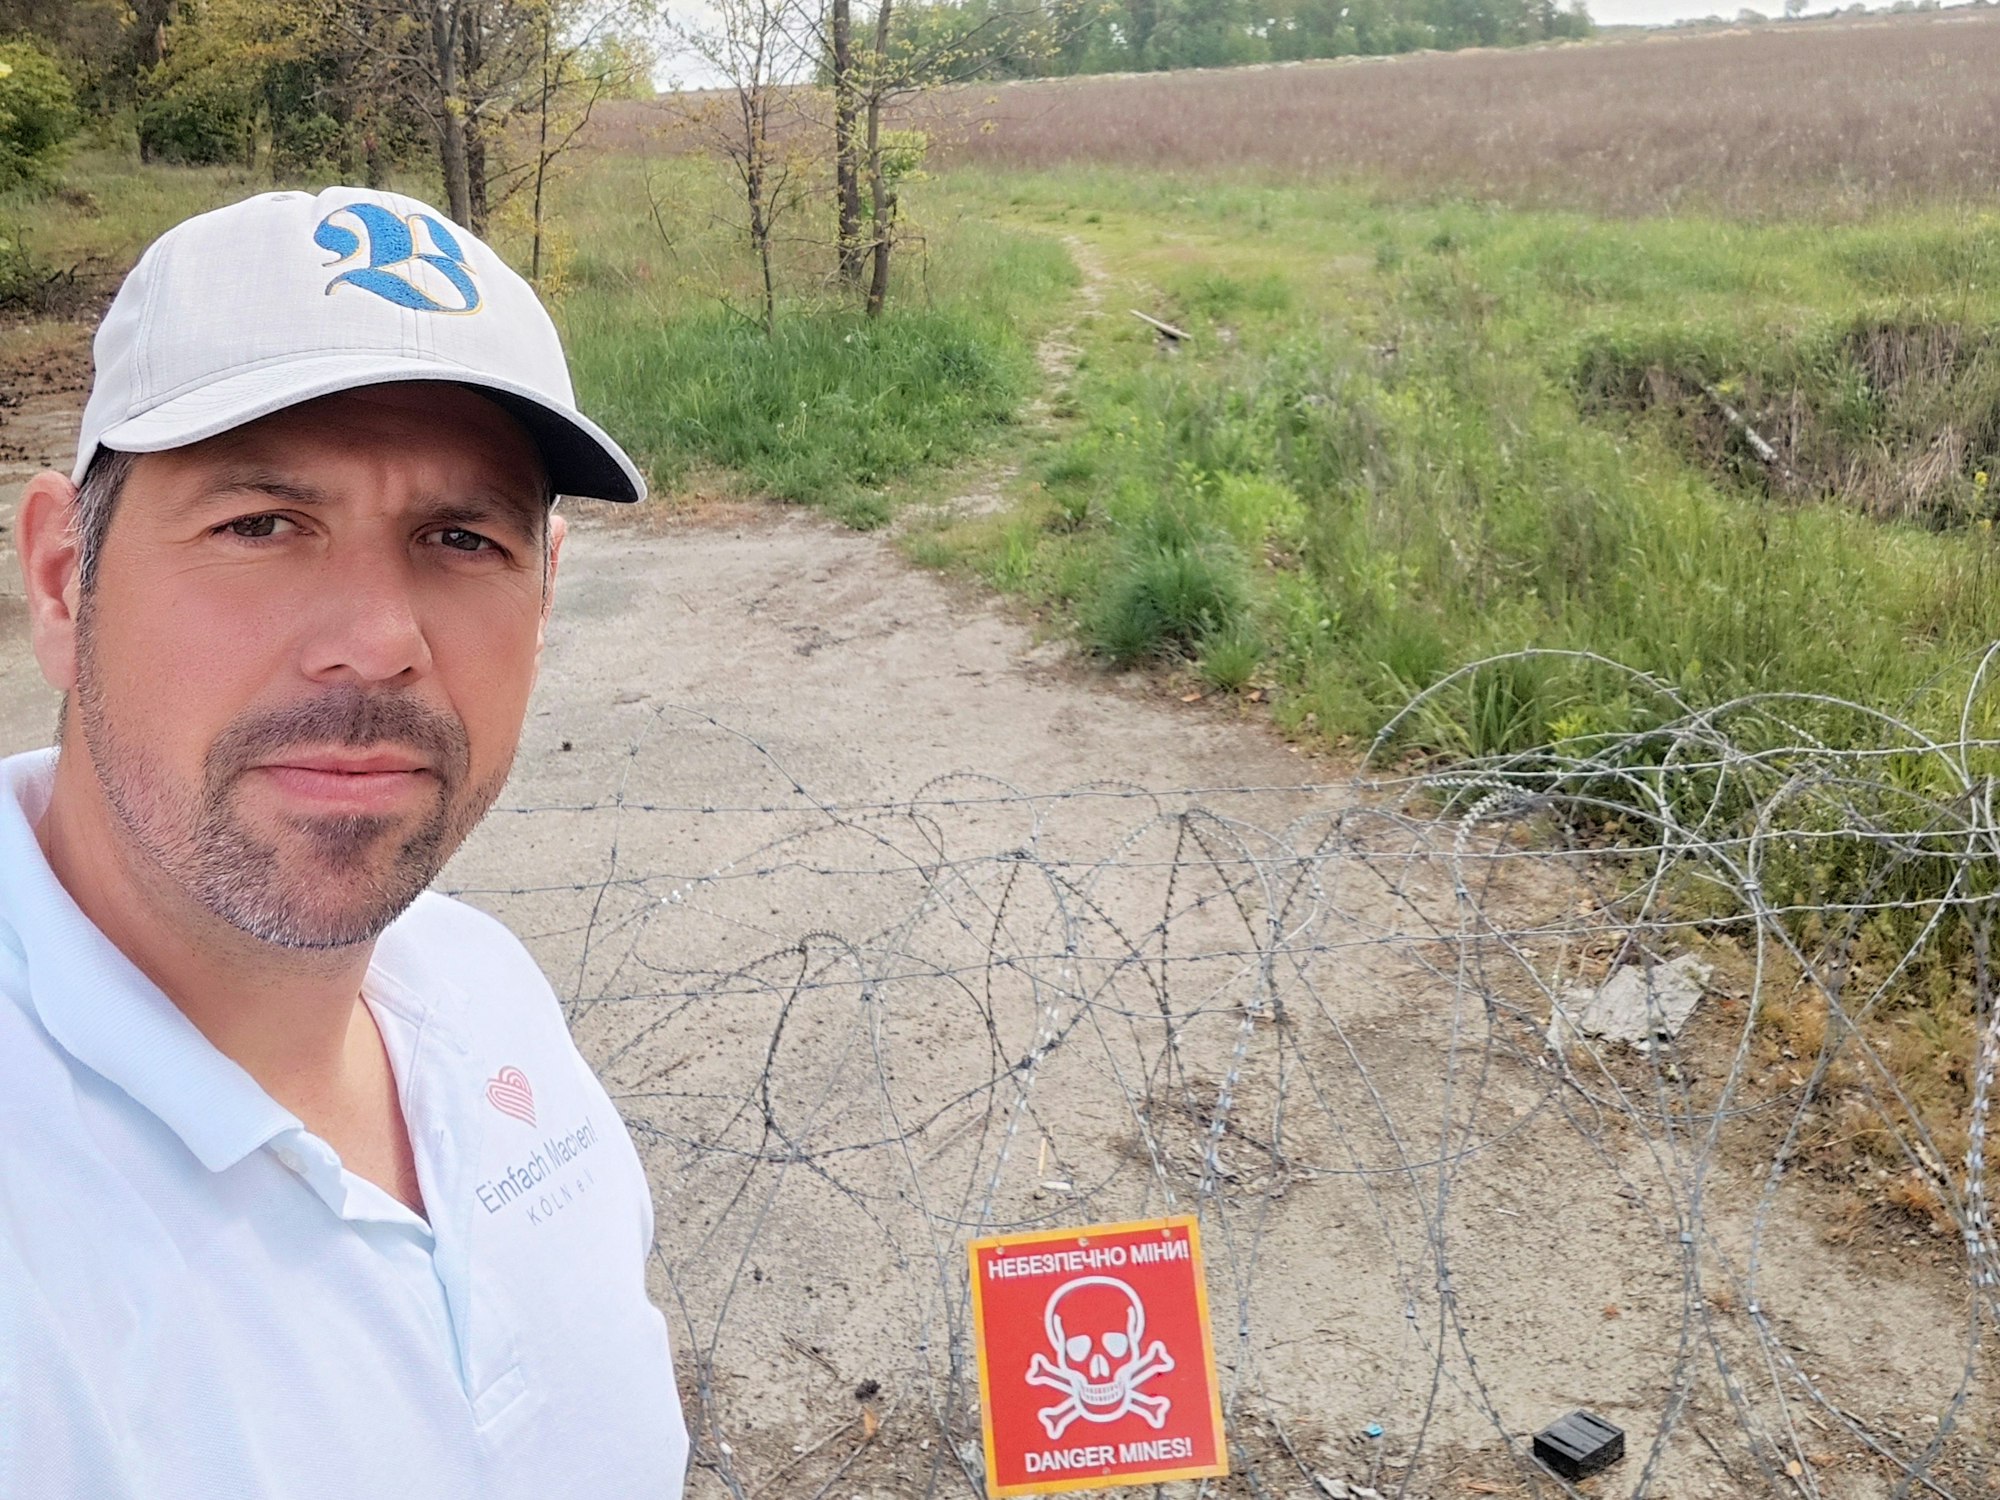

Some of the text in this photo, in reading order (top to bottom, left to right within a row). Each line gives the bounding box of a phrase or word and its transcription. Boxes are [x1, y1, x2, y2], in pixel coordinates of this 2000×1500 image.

[475, 1150, 551, 1214] Einfach
[988, 1239, 1189, 1280] НЕБЕЗПЕЧНО МІНИ!
[1025, 1437, 1193, 1473] DANGER MINES!
